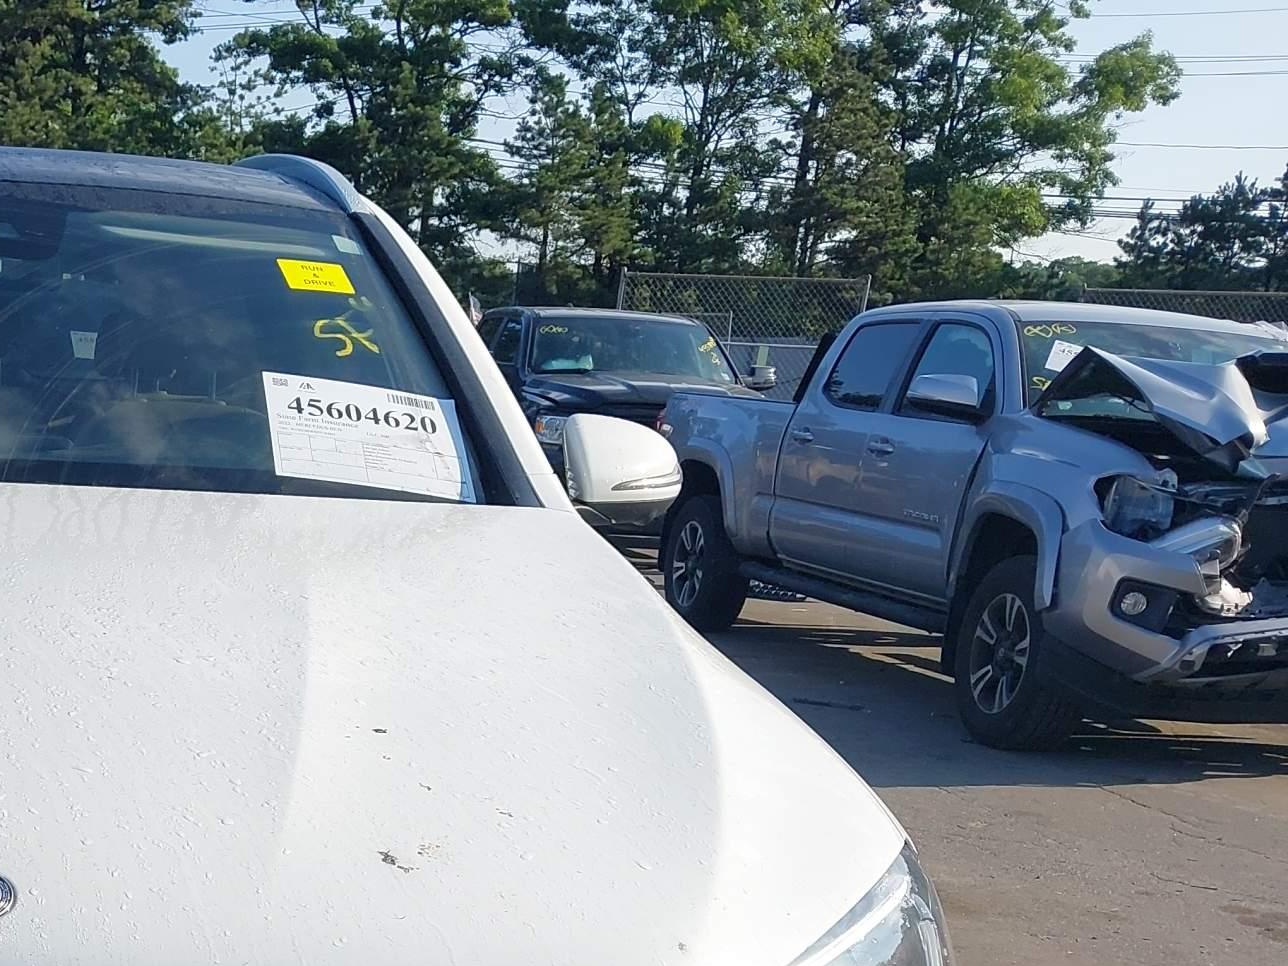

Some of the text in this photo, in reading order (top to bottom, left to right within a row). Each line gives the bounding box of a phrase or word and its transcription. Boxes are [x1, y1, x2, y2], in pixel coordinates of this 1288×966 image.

[300, 264, 324, 272] RUN
[303, 279, 336, 287] DRIVE
[287, 396, 437, 435] 45604620
